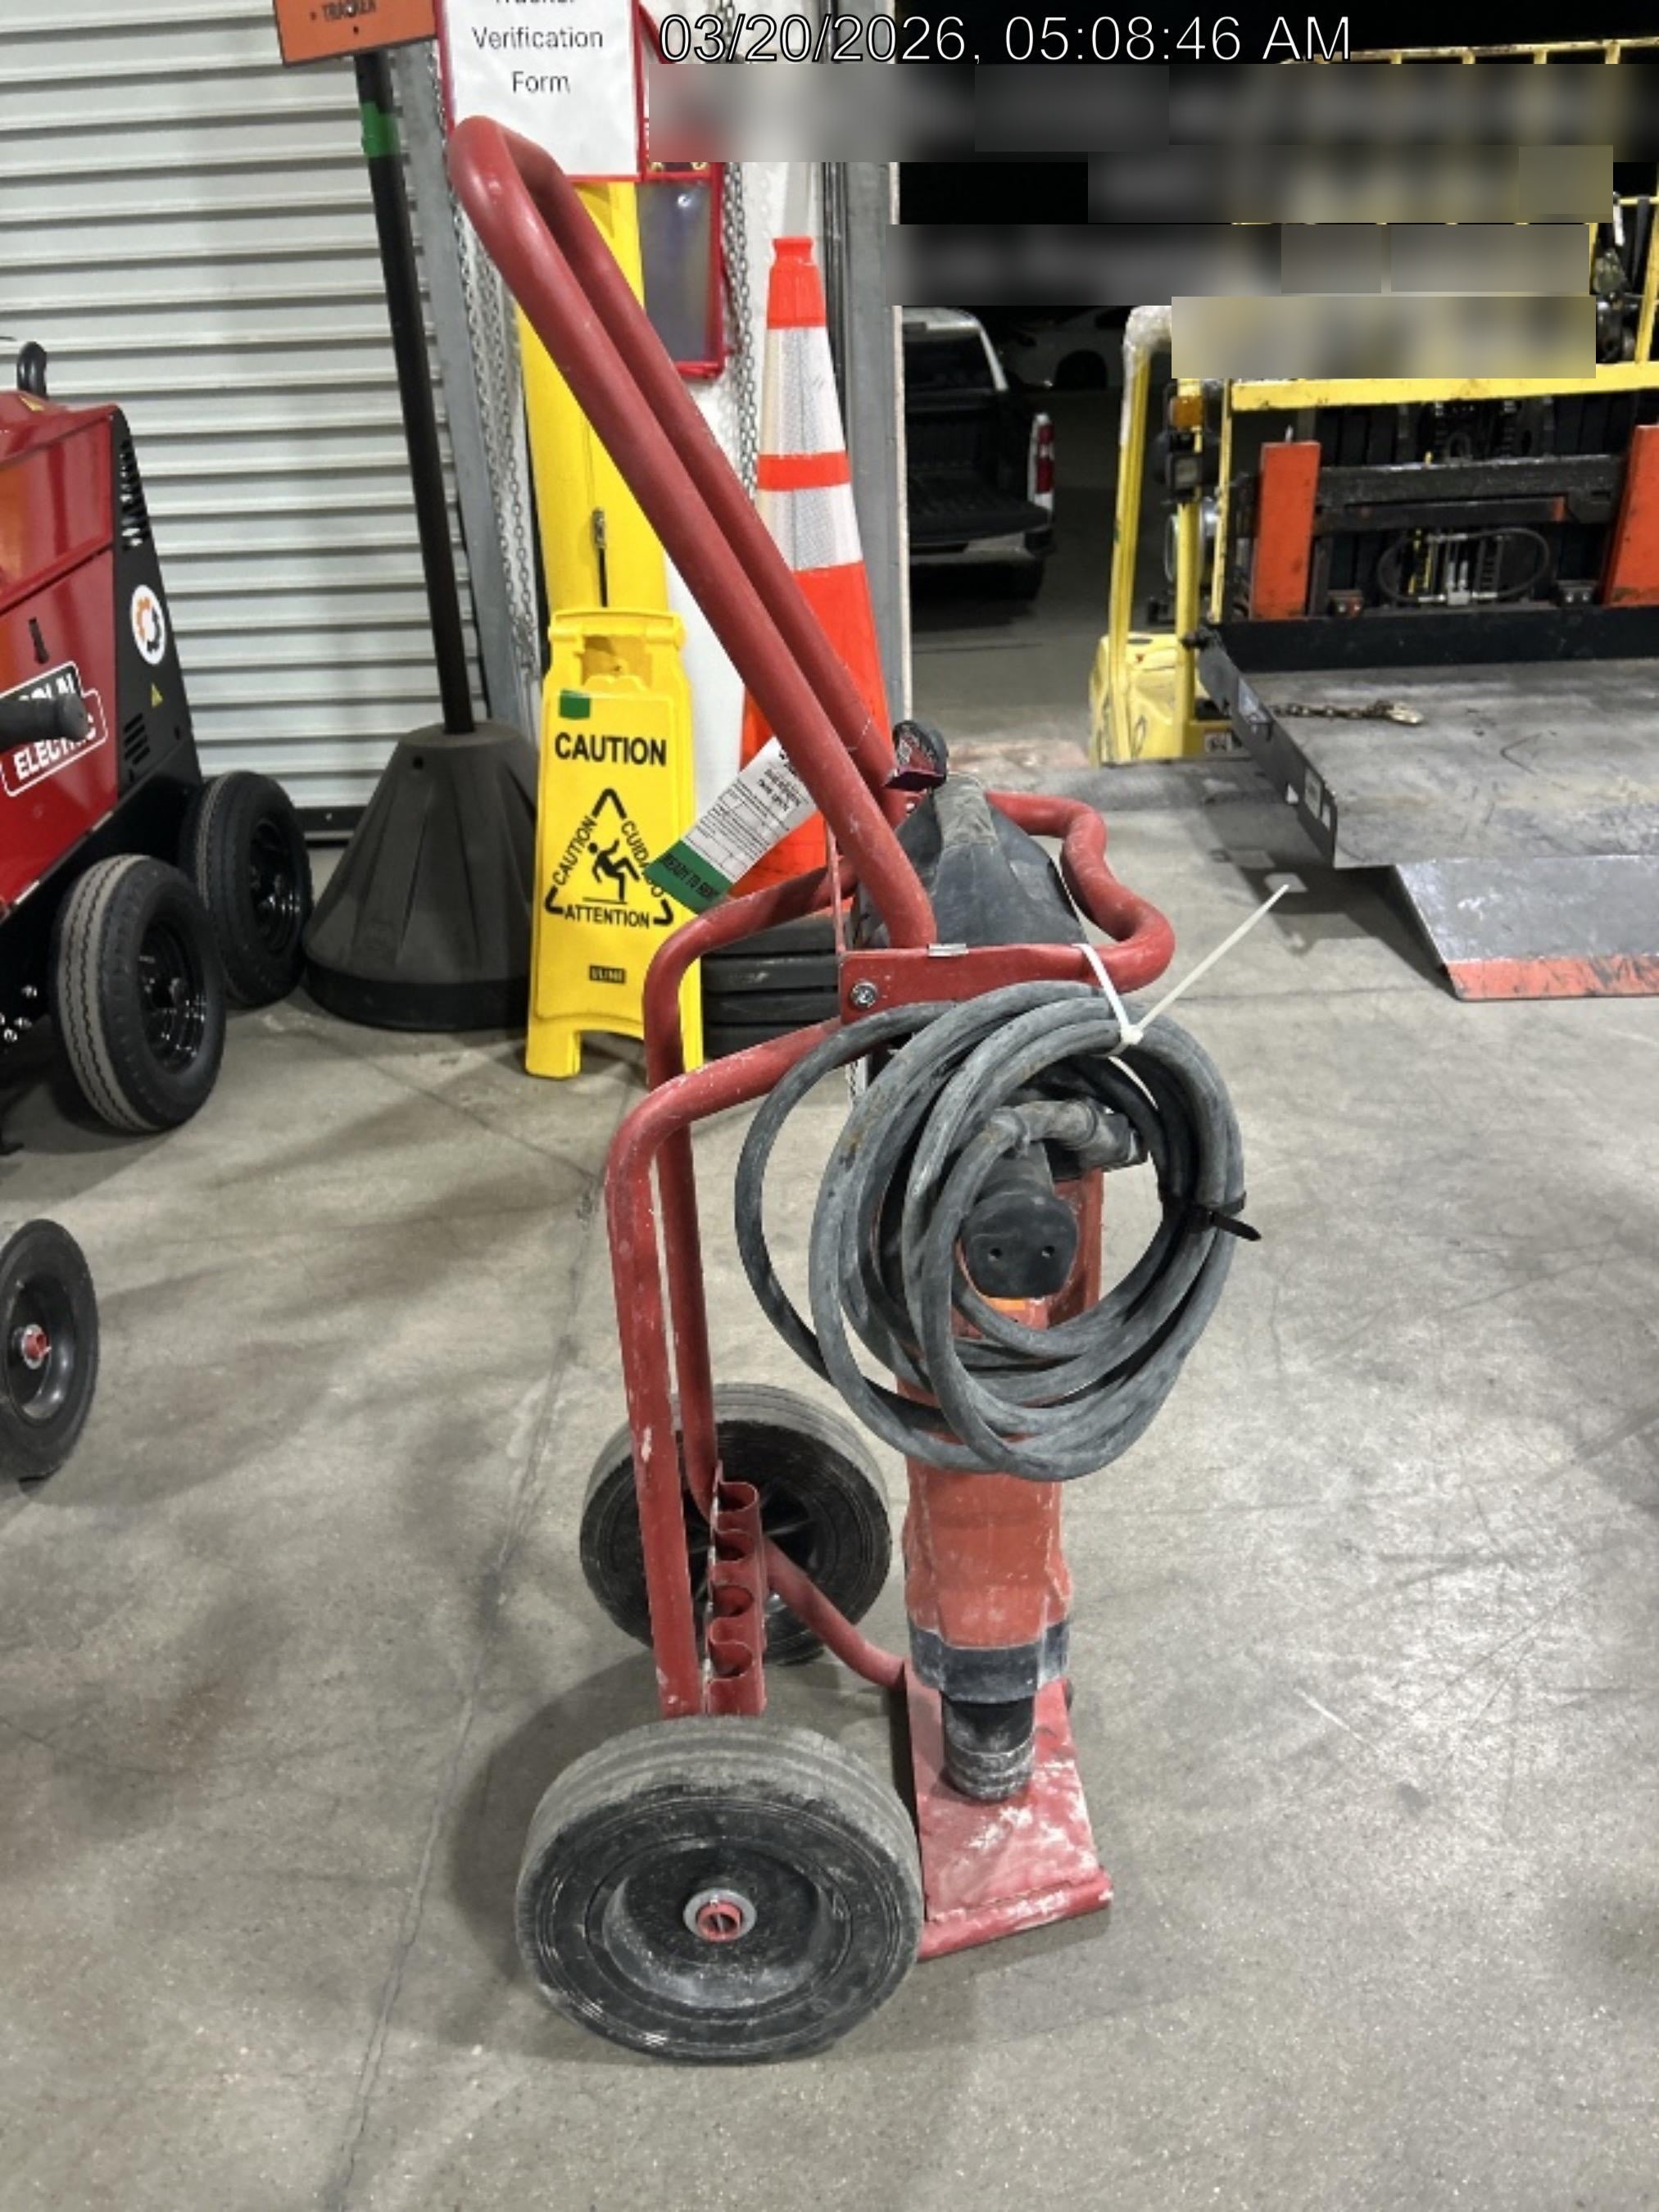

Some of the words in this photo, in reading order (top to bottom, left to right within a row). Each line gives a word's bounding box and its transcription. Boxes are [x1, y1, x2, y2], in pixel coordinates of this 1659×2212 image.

[471, 26, 603, 49] Verification
[511, 70, 571, 93] Form
[13, 711, 97, 780] ELECT
[555, 732, 667, 767] CAUTION
[552, 815, 598, 886] CAUTION
[620, 820, 664, 898] CUIDO
[564, 904, 650, 929] ATTENTION
